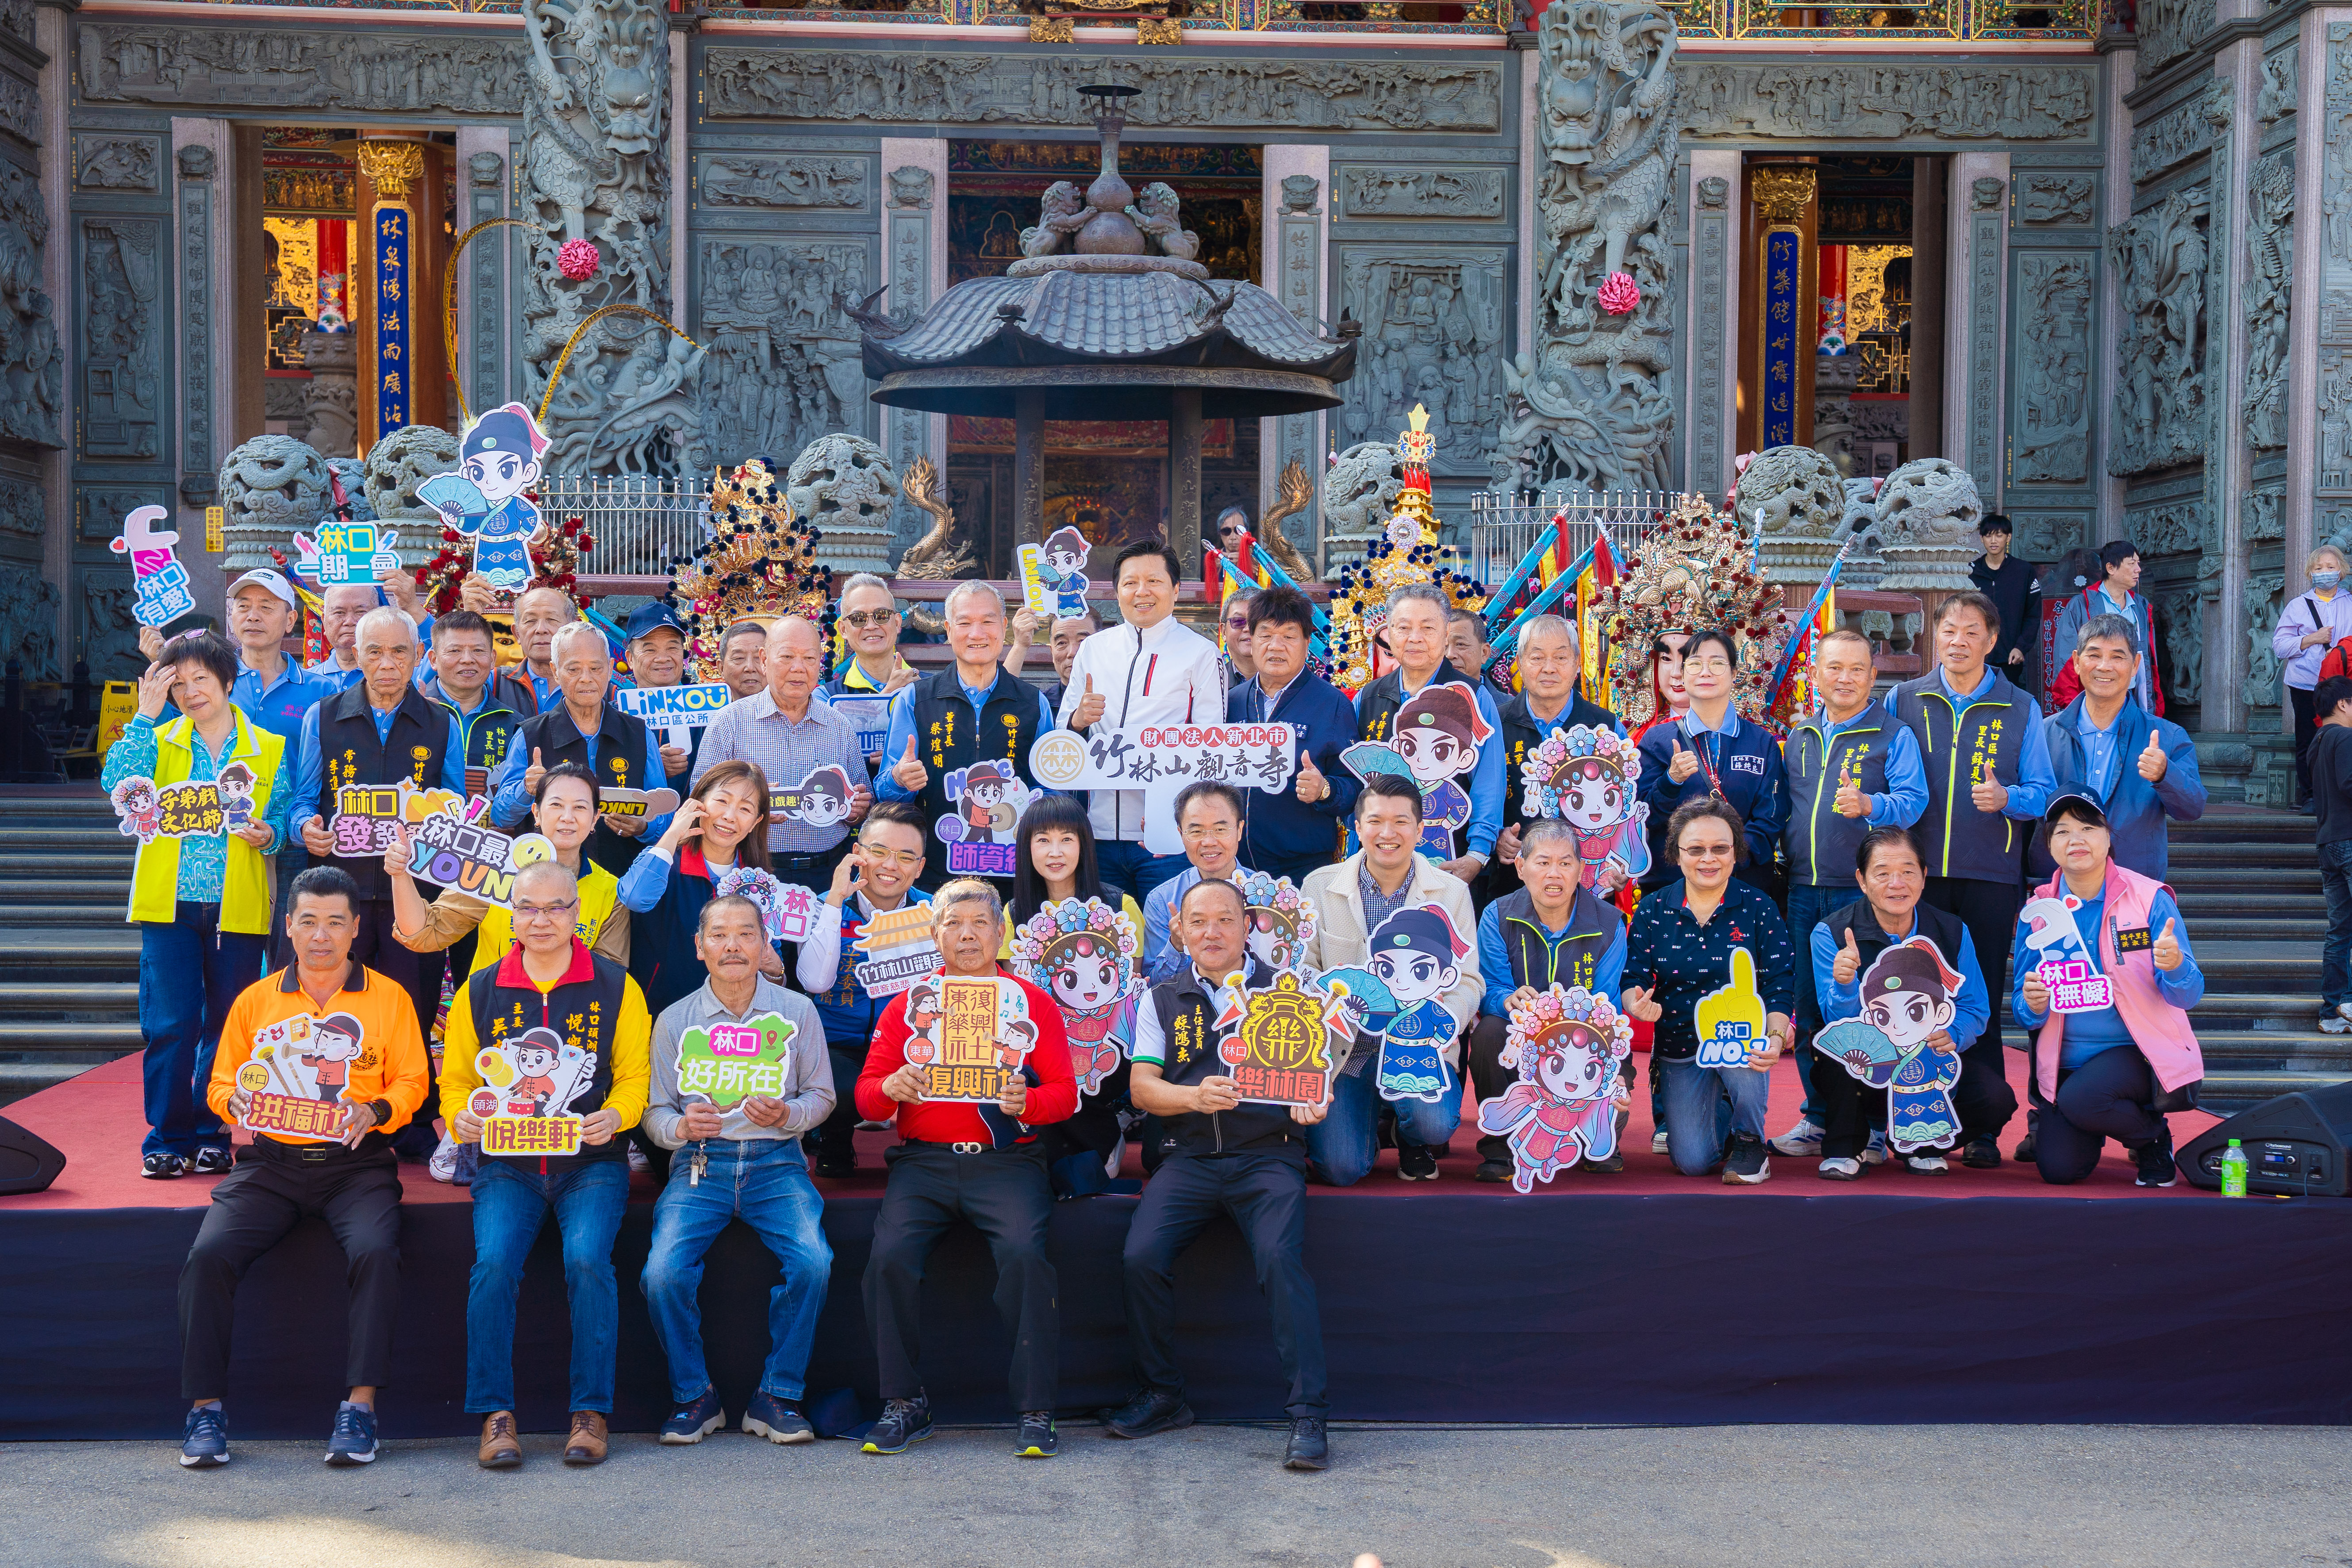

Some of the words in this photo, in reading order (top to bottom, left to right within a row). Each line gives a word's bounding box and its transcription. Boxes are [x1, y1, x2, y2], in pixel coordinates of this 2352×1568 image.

[320, 527, 374, 553] 林口
[140, 563, 184, 596] 林口
[299, 553, 397, 580] 一期一會
[1022, 549, 1045, 612] LINKOU
[139, 586, 191, 624] 有愛
[2044, 620, 2053, 687] 竹林山觀音寺
[106, 704, 133, 714] 小心地滑
[646, 713, 708, 727] 林口區公所
[484, 731, 494, 750] 里長
[496, 726, 507, 757] 林口區
[944, 711, 955, 747] 董事長
[1143, 728, 1285, 746] 財團法人新北市
[1376, 711, 1388, 742] 常務董
[1975, 725, 1988, 749] 里長
[1988, 719, 2003, 754] 林口區
[930, 722, 943, 768] 蔡煌明
[1090, 734, 1288, 787] 竹林山觀音寺
[1853, 743, 1870, 774] 林口區
[342, 749, 357, 784] 常務
[160, 785, 217, 810] 子弟戲
[344, 790, 397, 816] 林口
[599, 801, 645, 815] LINKO
[161, 809, 223, 832] 文化節
[940, 824, 961, 835] 林口
[425, 817, 508, 867] 林口最
[415, 845, 515, 902] YOUN
[780, 888, 811, 937] 林口
[2120, 931, 2150, 941] 瑞平里長
[837, 945, 858, 1007] 立法委員
[2042, 962, 2087, 986] 林口
[512, 1003, 524, 1028] 主委
[587, 1001, 601, 1052] 林口頭湖
[1193, 1004, 1205, 1049] 主任委員
[1717, 1022, 1750, 1039] 林口
[713, 1030, 757, 1052] 林口
[910, 1045, 933, 1057] 東華
[1223, 1045, 1247, 1057] 林口
[241, 1071, 267, 1084] 林口
[685, 1059, 780, 1094] 好所在
[923, 1066, 1011, 1097] 復興社
[1236, 1068, 1324, 1102] 樂林園
[250, 1093, 347, 1135] 洪福社
[473, 1098, 498, 1111] 頭湖
[486, 1118, 578, 1151] 悅樂軒
